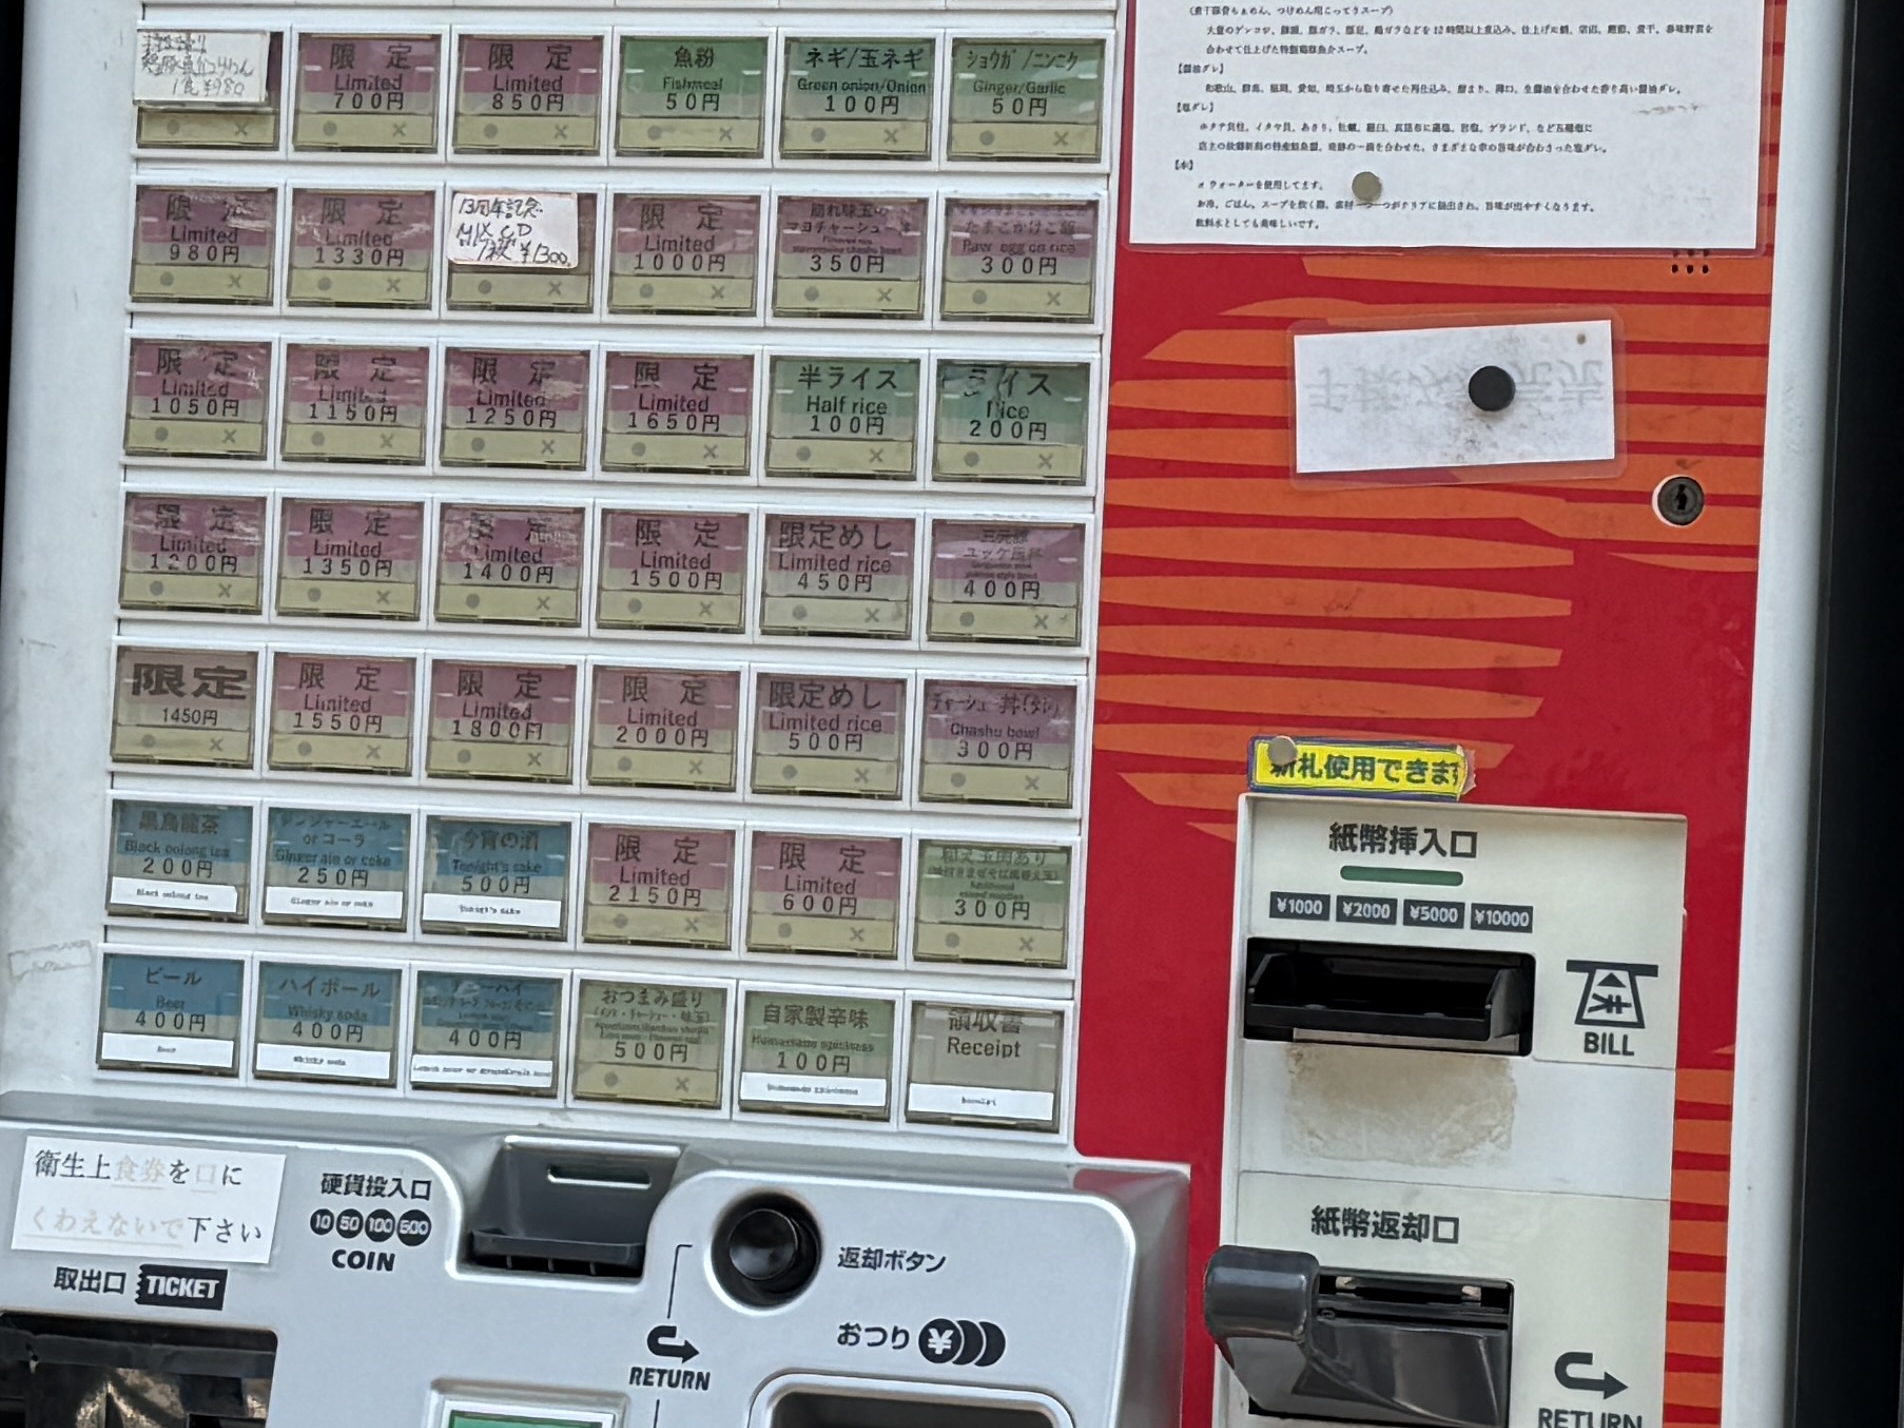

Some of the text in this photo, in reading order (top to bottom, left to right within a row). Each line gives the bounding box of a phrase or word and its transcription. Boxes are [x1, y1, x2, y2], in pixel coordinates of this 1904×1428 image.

[674, 46, 714, 68] 魚粉
[334, 94, 404, 110] 700円
[799, 365, 897, 390] 半ライス
[806, 396, 887, 414] Half rice
[778, 521, 891, 550] 限定めし
[162, 709, 217, 726] 1450円
[1329, 822, 1478, 859] 紙幣挿入口
[462, 877, 530, 894] 500円
[1277, 897, 1530, 928] ¥1000 ¥2000 ¥5000 ¥10000
[280, 978, 379, 997] ハイボール
[764, 1005, 868, 1029] 自家製辛味
[948, 1037, 1021, 1058] Receipt
[1583, 1032, 1636, 1057] BILL
[321, 1172, 431, 1201] 硬貨投入口
[30, 1205, 263, 1243] くわえないで下さい
[1311, 1206, 1460, 1244] 紙幣返却口
[332, 1249, 395, 1271] COIN
[837, 1246, 946, 1273] 返却ボタン
[54, 1267, 219, 1300] 取出口 TICKET
[837, 1323, 910, 1349] おつり
[630, 1367, 710, 1391] RETURN
